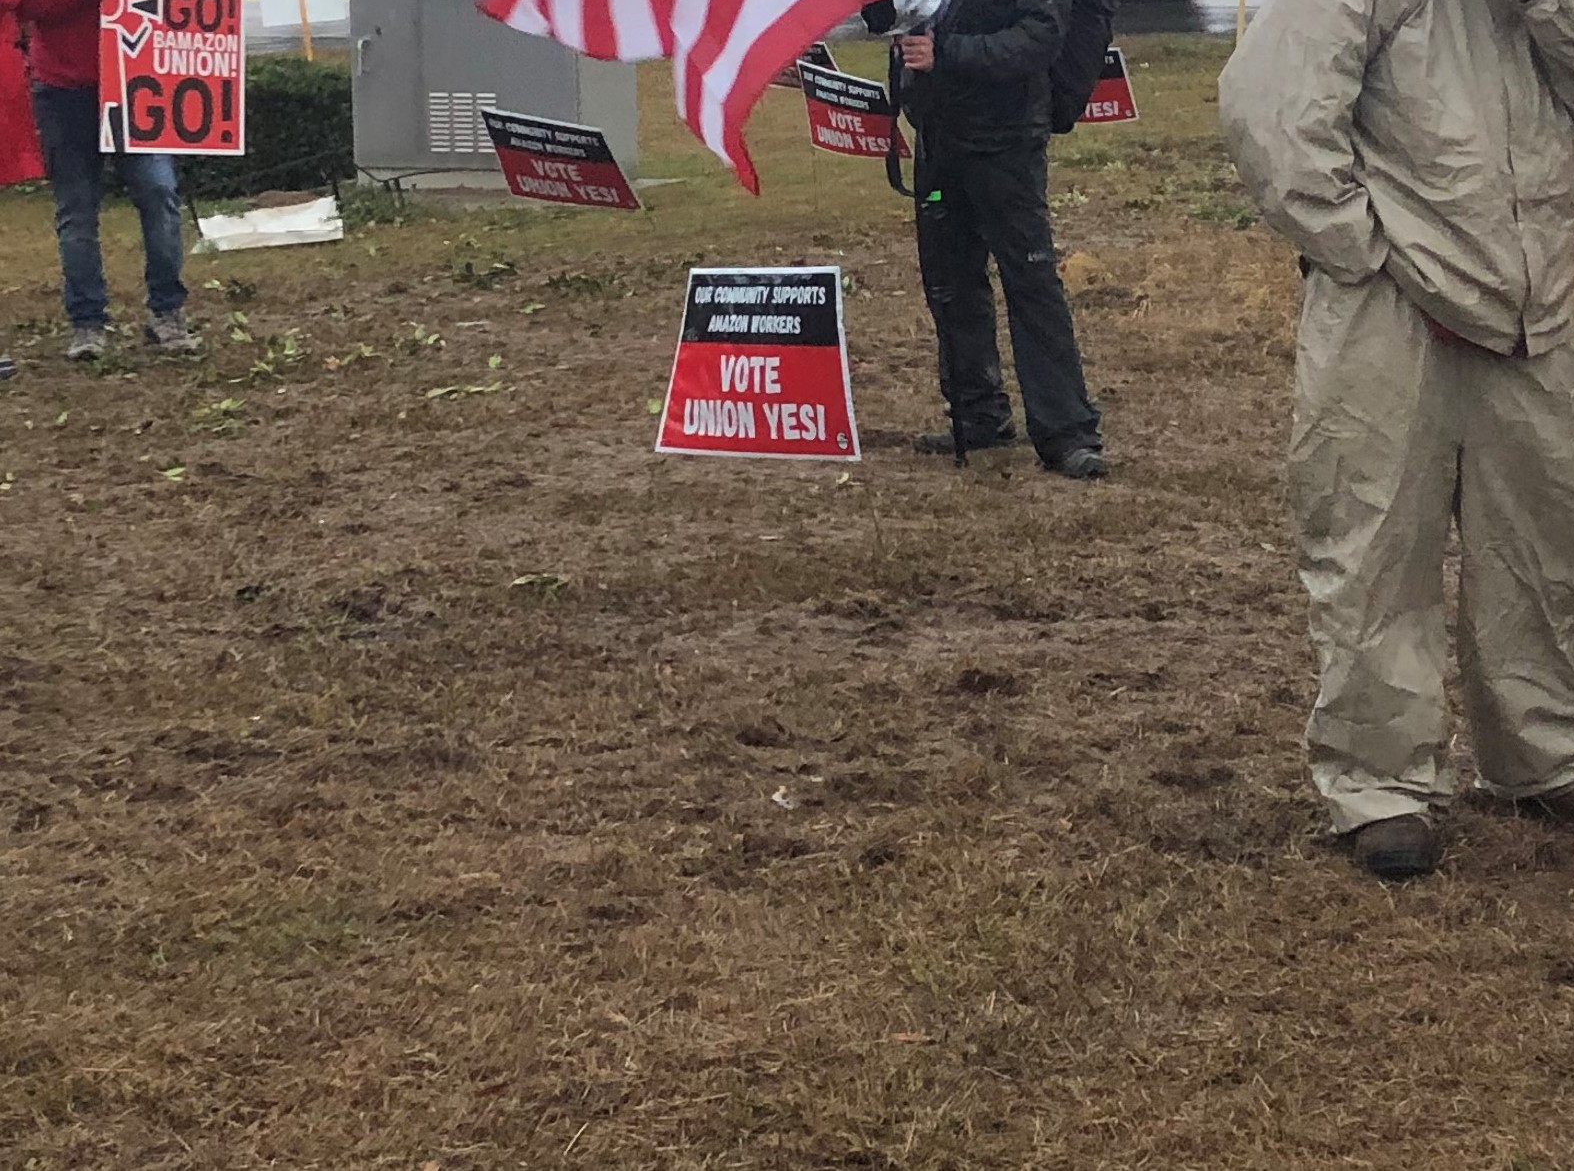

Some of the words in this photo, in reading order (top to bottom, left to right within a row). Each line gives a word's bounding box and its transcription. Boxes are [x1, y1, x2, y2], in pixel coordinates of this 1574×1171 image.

[153, 31, 238, 52] BAMAZON
[153, 49, 237, 77] UNION!
[127, 75, 232, 143] GO!
[828, 109, 865, 133] VOTE
[816, 124, 855, 149] UNION
[530, 158, 583, 182] VOTE
[516, 174, 572, 198] UNION
[695, 286, 712, 304] OUR
[714, 286, 770, 305] COMMUNITY
[771, 286, 826, 305] SUPPORTS
[707, 314, 749, 333] AMAZON
[750, 315, 801, 335] WORKERS
[720, 354, 781, 394] VOTE
[683, 398, 756, 439] UNION
